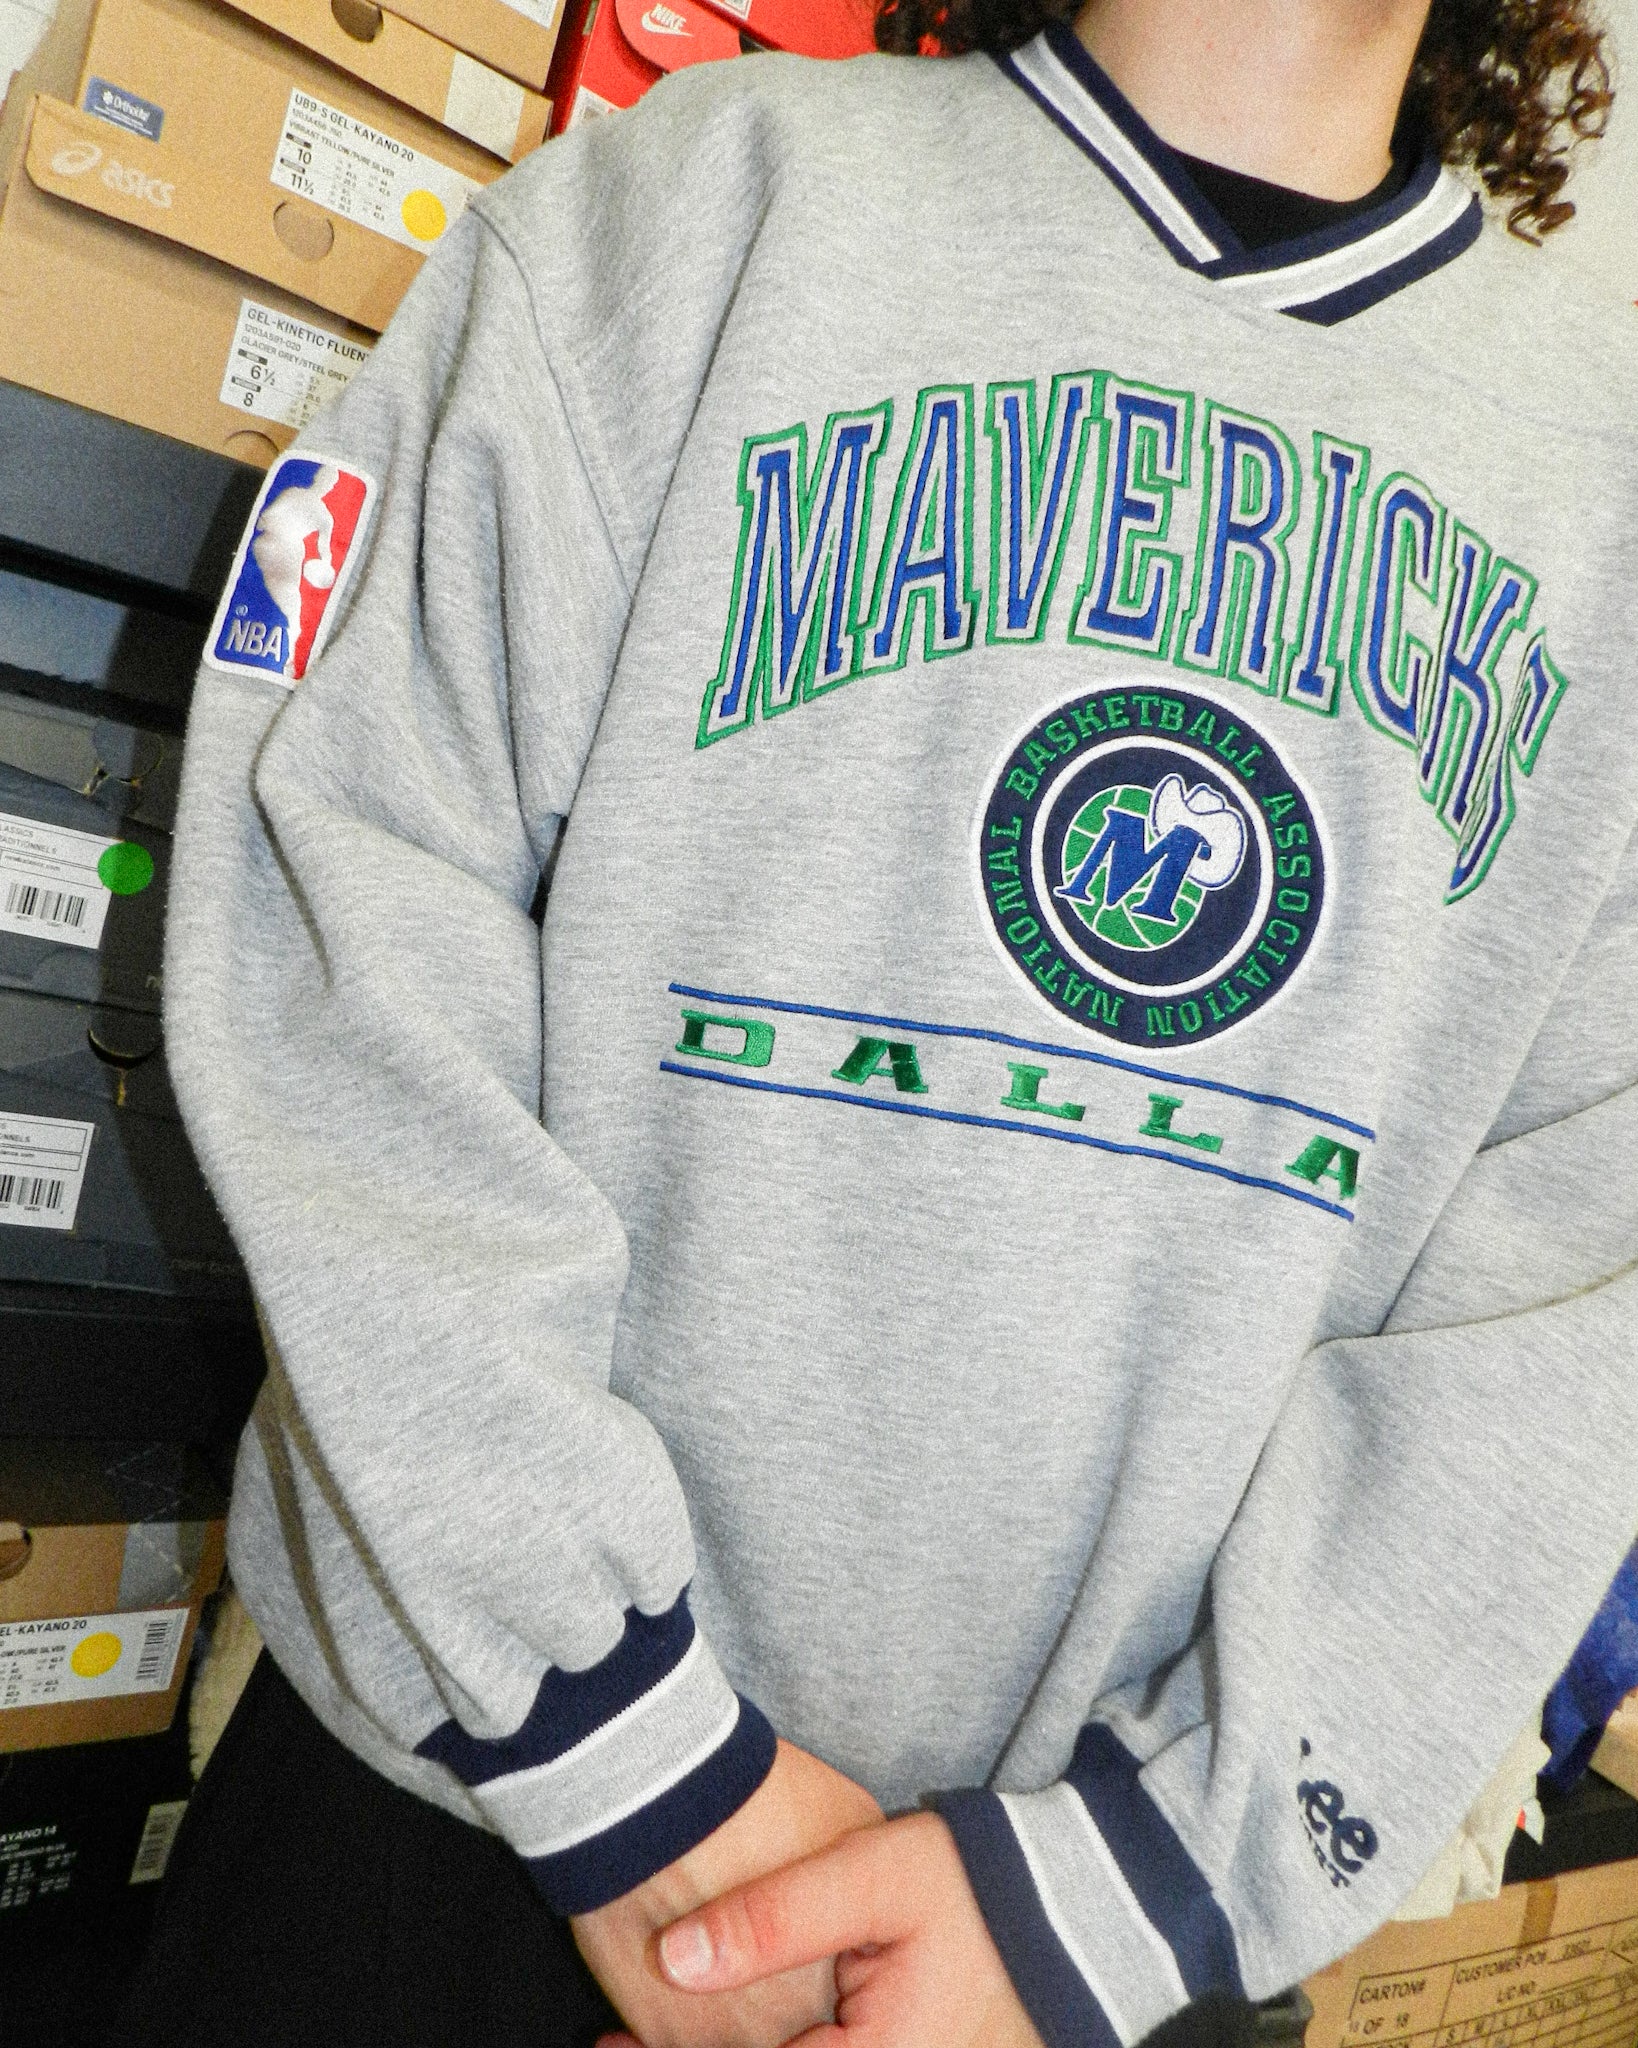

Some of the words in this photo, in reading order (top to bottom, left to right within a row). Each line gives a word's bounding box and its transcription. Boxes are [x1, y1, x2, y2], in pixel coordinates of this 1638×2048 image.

[650, 3, 687, 31] NIKE
[297, 148, 312, 165] 10
[330, 112, 399, 155] GEL-KAYANO
[400, 148, 415, 162] 20
[247, 307, 325, 347] GEL-KINETIC
[327, 338, 369, 362] FLUEN
[240, 335, 277, 355] GLACIER
[277, 349, 325, 376] GREY/STEEL
[327, 368, 349, 384] GREY
[243, 392, 254, 407] 8
[224, 618, 284, 663] NBA
[694, 368, 1570, 906] MAVERICKS
[1005, 694, 1264, 800] BASKETBALL
[0, 834, 58, 855] ADITIONNELS
[1054, 806, 1213, 924] M
[988, 816, 1125, 1027] NATIONAL
[1146, 792, 1312, 1037] ASSOCIATION
[72, 1619, 87, 1630] 20
[1296, 1736, 1379, 1874] ee
[1363, 2016, 1384, 2035] OF
